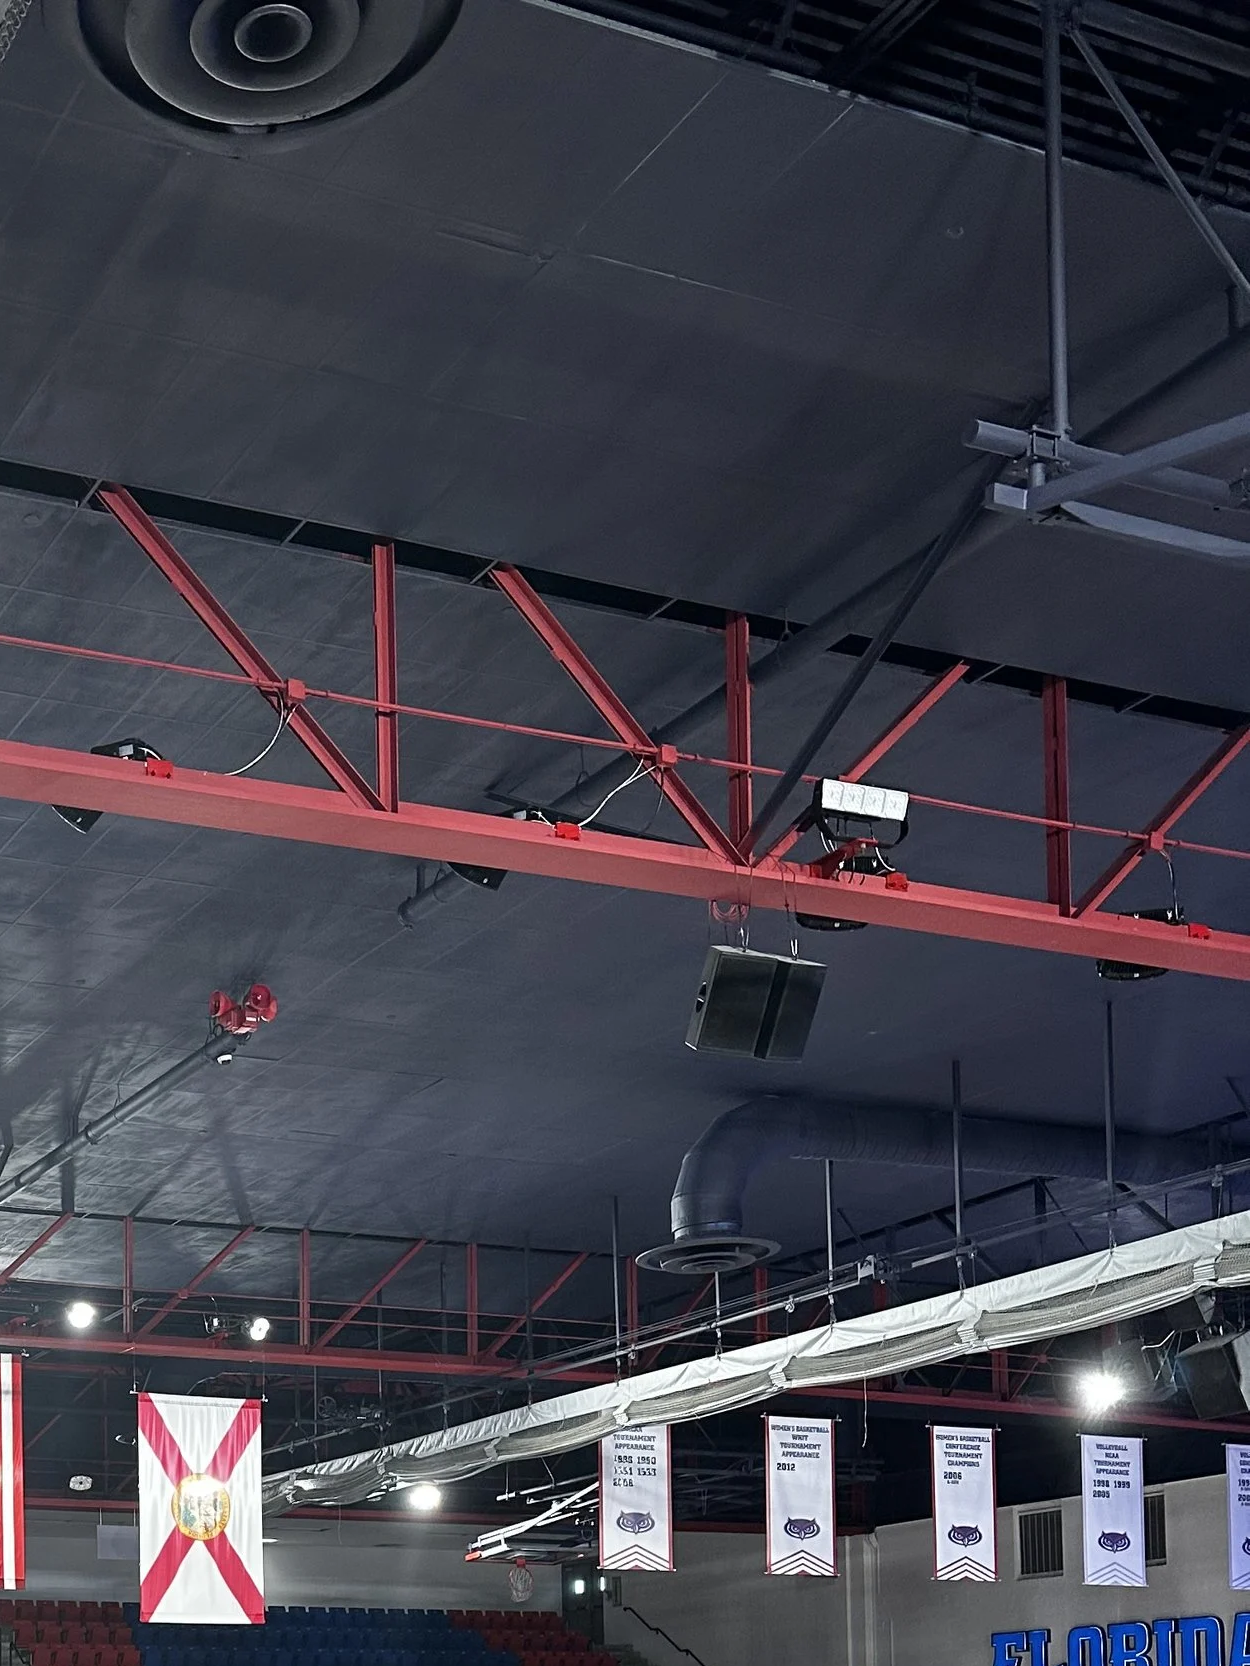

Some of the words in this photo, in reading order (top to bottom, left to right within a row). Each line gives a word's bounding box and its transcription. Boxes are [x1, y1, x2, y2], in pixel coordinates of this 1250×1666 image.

[613, 1434, 656, 1442] TOURNAMENT
[614, 1443, 655, 1451] APPEARANCE
[780, 1442, 821, 1450] TOURNAMENT
[781, 1451, 820, 1459] APPEARANCE
[776, 1462, 796, 1471] 2012
[943, 1471, 962, 1480] 2006
